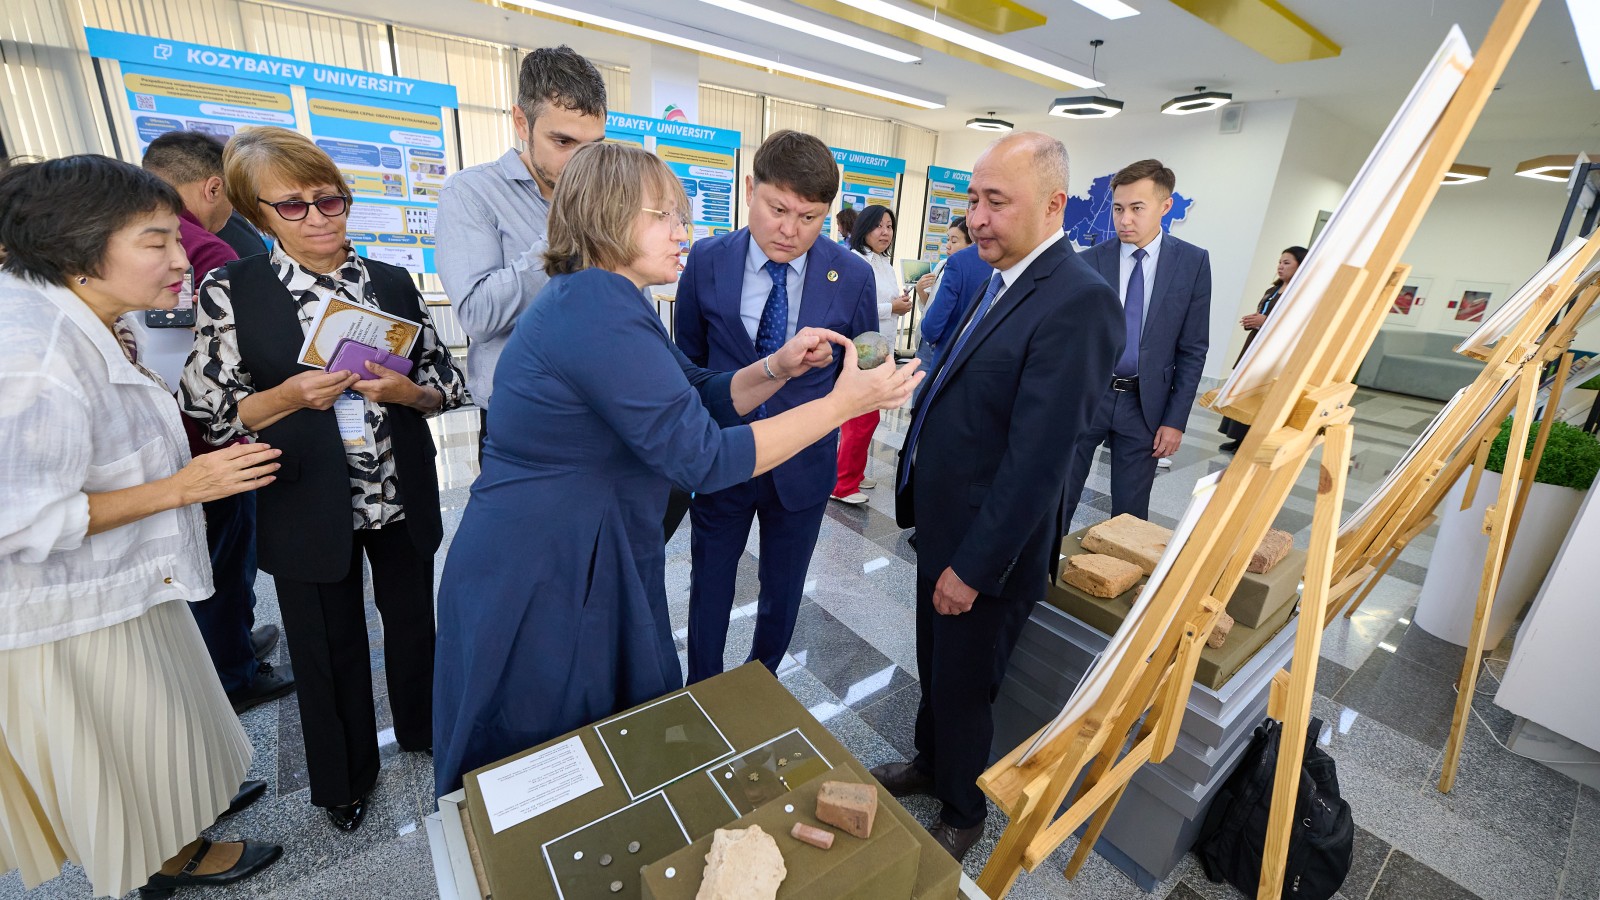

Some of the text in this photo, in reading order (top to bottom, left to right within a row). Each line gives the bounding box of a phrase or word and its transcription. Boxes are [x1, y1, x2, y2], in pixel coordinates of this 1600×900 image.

[187, 48, 414, 96] KOZYBAYEV UNIVERSITY
[606, 115, 716, 140] ZYBAYEV UNIVERSITY
[849, 153, 889, 167] UNIVERSITY
[952, 172, 971, 181] KOZYB
